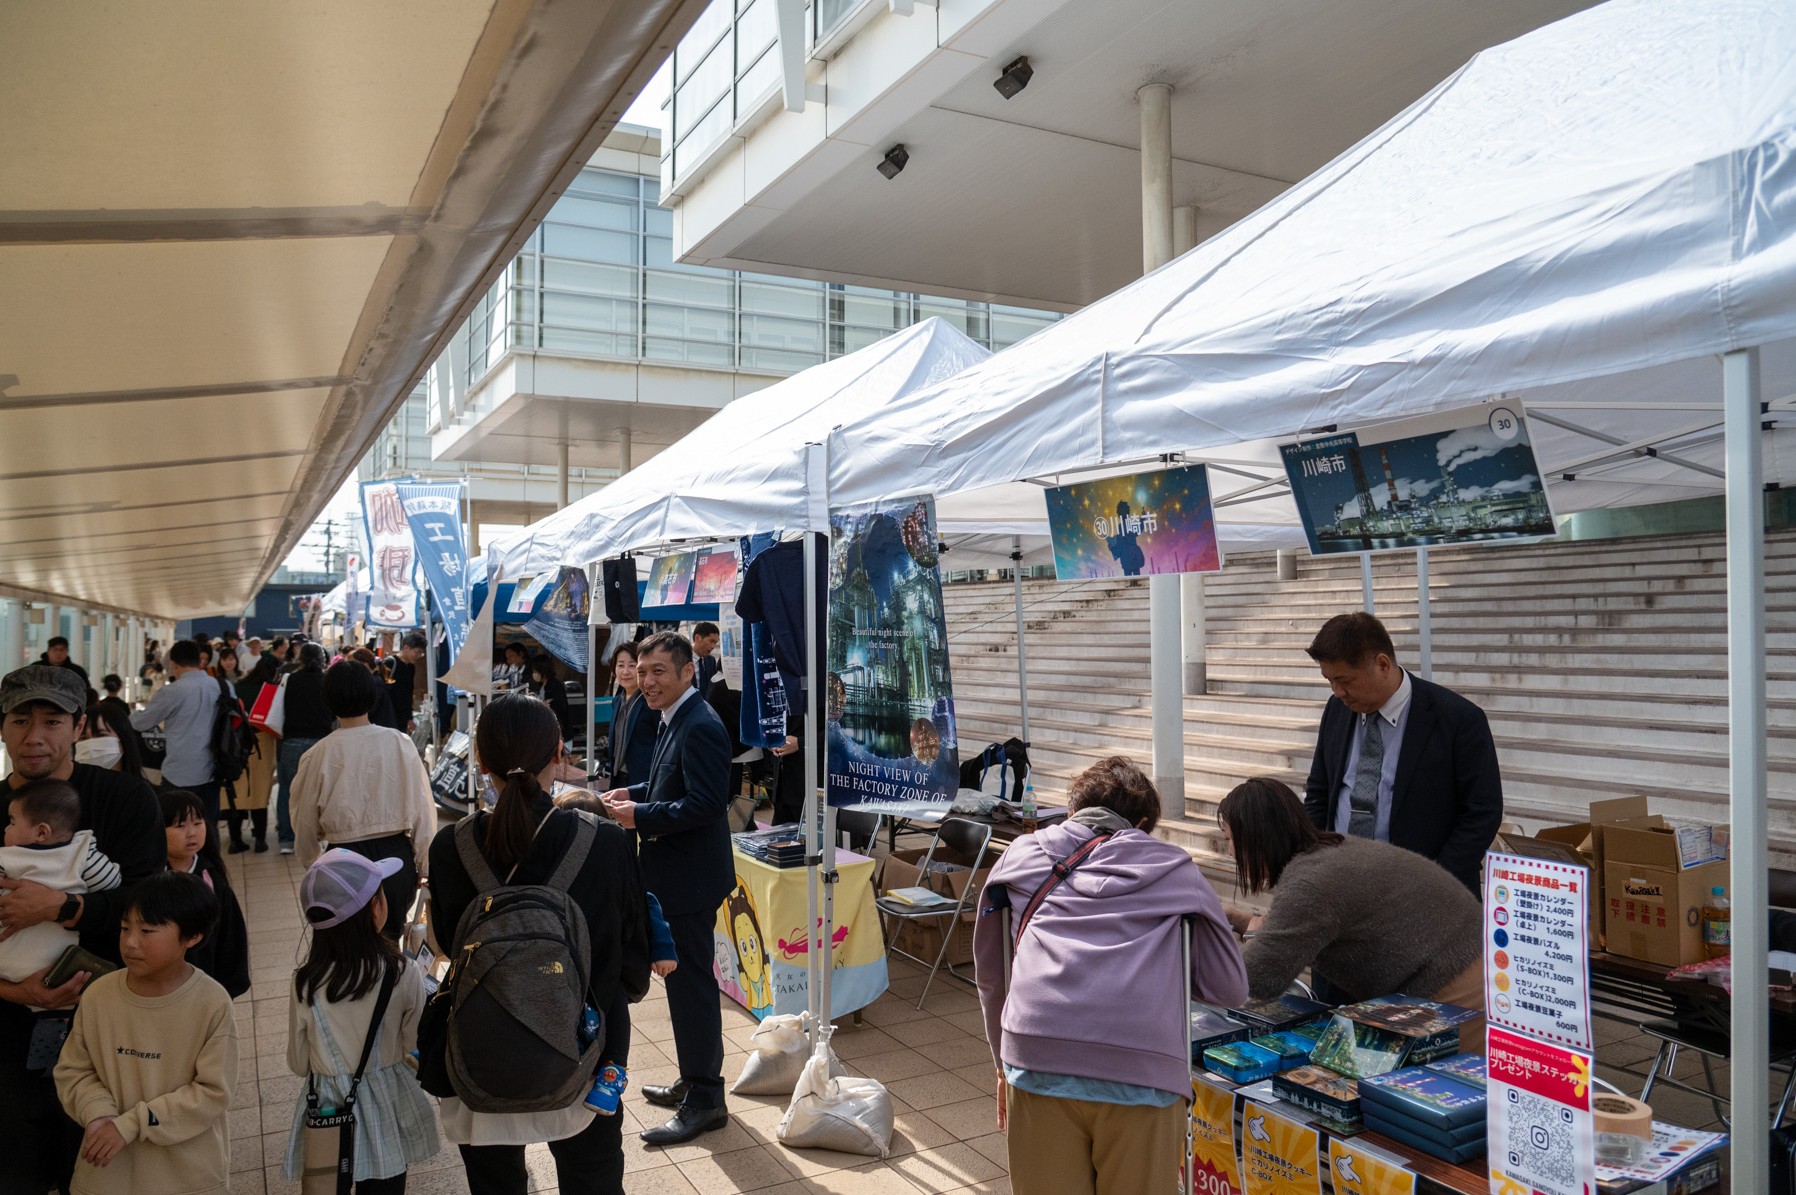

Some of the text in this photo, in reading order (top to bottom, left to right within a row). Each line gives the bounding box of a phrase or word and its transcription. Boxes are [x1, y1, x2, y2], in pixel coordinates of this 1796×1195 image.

[1497, 418, 1511, 430] 30
[1302, 455, 1346, 477] 川崎市
[852, 627, 877, 636] Beautiful
[878, 628, 892, 638] night
[893, 629, 908, 637] scene
[868, 640, 878, 649] the
[848, 760, 930, 786] NIGHT VIEW OF
[830, 772, 947, 806] THE FACTORY ZONE OF
[1492, 868, 1578, 894] 川崎工場夜景商品一覧
[1513, 888, 1574, 906] 工場夜景カレンダー
[1513, 910, 1574, 927] 工場夜景カレンダー
[1546, 905, 1574, 918] 2,400円
[1513, 933, 1560, 950] 工場夜景パズル
[1546, 927, 1574, 940] 1,600円
[1513, 955, 1554, 971] ヒカリノイズミ
[1544, 950, 1573, 964] 4,200円
[1515, 978, 1557, 994] ヒカリノイズミ
[1515, 999, 1563, 1019] 工場夜景豆菓子
[1555, 1021, 1578, 1033] 600円
[1490, 1058, 1532, 1080] プレゼント
[1250, 1144, 1313, 1177] 川崎工場夜景クッキー
[1251, 1157, 1294, 1181] ヒカリノイズミ
[1251, 1168, 1273, 1182] C-BOX
